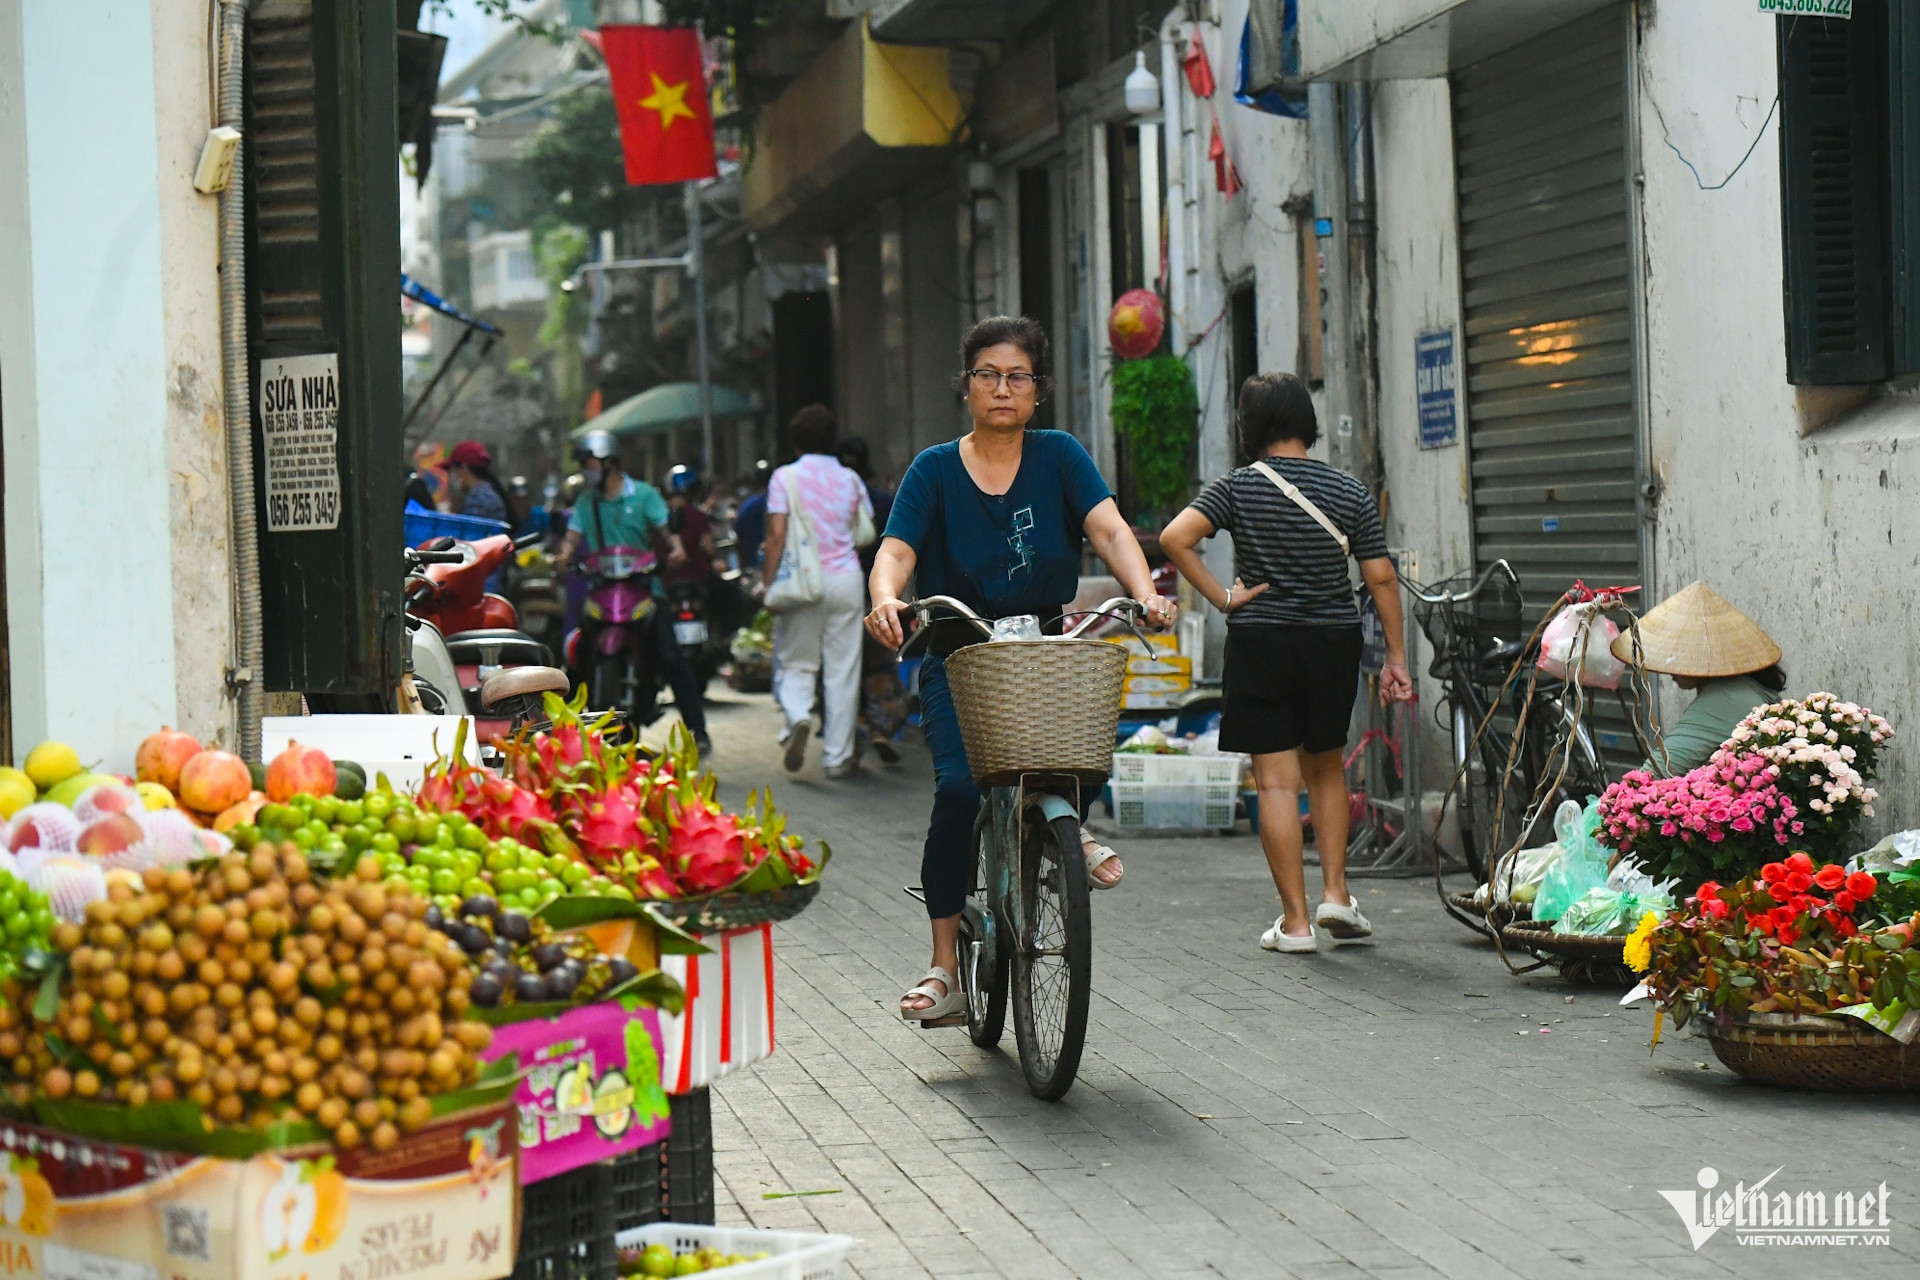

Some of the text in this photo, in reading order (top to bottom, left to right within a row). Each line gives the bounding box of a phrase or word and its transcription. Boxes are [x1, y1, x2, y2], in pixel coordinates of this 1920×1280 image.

[265, 365, 337, 412] SỬA NHÀ
[270, 493, 289, 526] 056
[292, 492, 312, 525] 255
